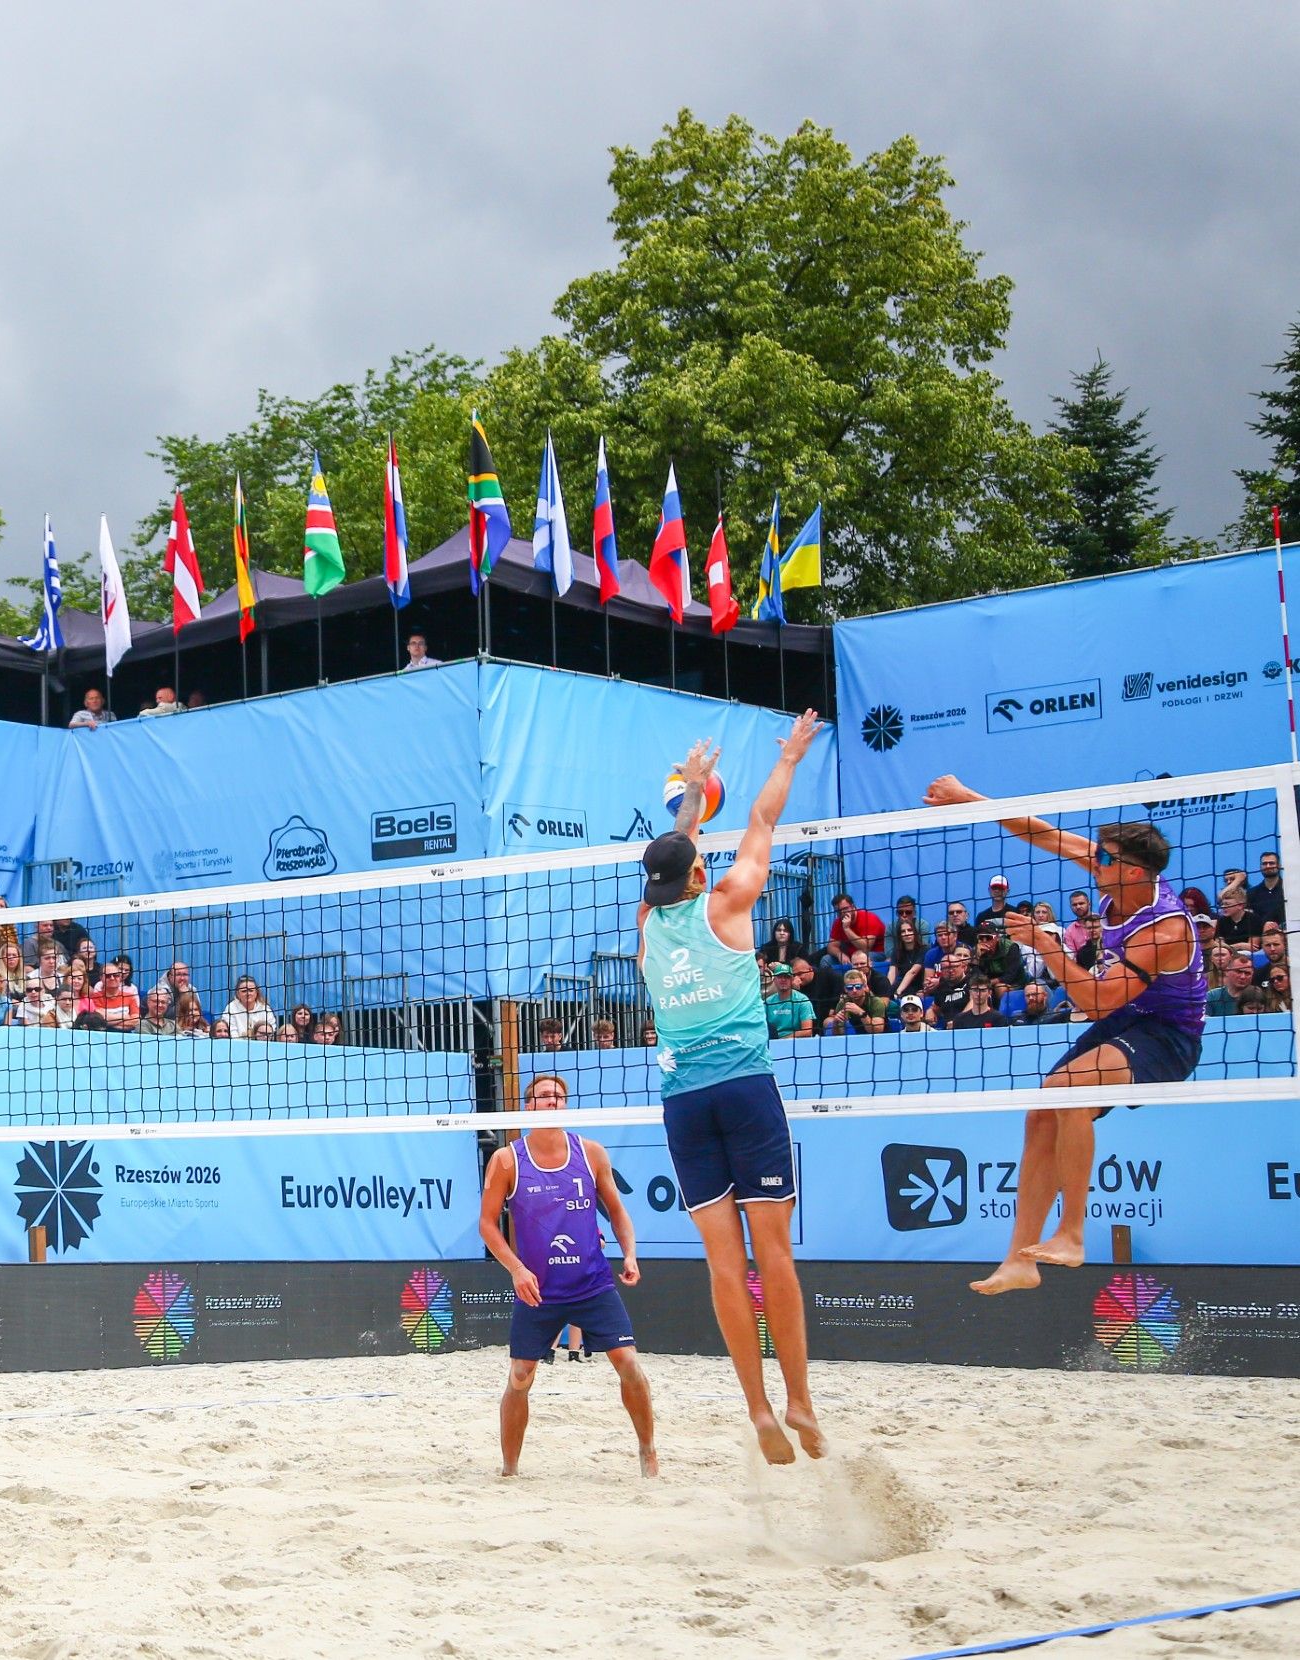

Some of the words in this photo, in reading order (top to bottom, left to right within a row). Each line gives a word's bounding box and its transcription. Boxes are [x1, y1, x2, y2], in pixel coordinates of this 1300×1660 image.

[1156, 670, 1248, 692] venidesign
[1029, 692, 1096, 715] ORLEN
[1162, 697, 1201, 708] PODŁOGI
[1214, 691, 1243, 701] DRZWI
[946, 707, 967, 718] 2026
[375, 811, 452, 838] Boels
[537, 818, 584, 838] ORLEN
[174, 847, 219, 858] Ministerstwo
[424, 837, 452, 851] RENTAL
[670, 947, 692, 973] 2
[662, 968, 705, 988] SWE
[659, 984, 724, 1010] RAMÉN
[115, 1164, 181, 1184] Rzeszów
[185, 1166, 221, 1184] 2026
[280, 1175, 452, 1217] EuroVolley.TV
[566, 1198, 591, 1211] SLO
[548, 1255, 580, 1265] ORLEN
[878, 1294, 914, 1309] 2026
